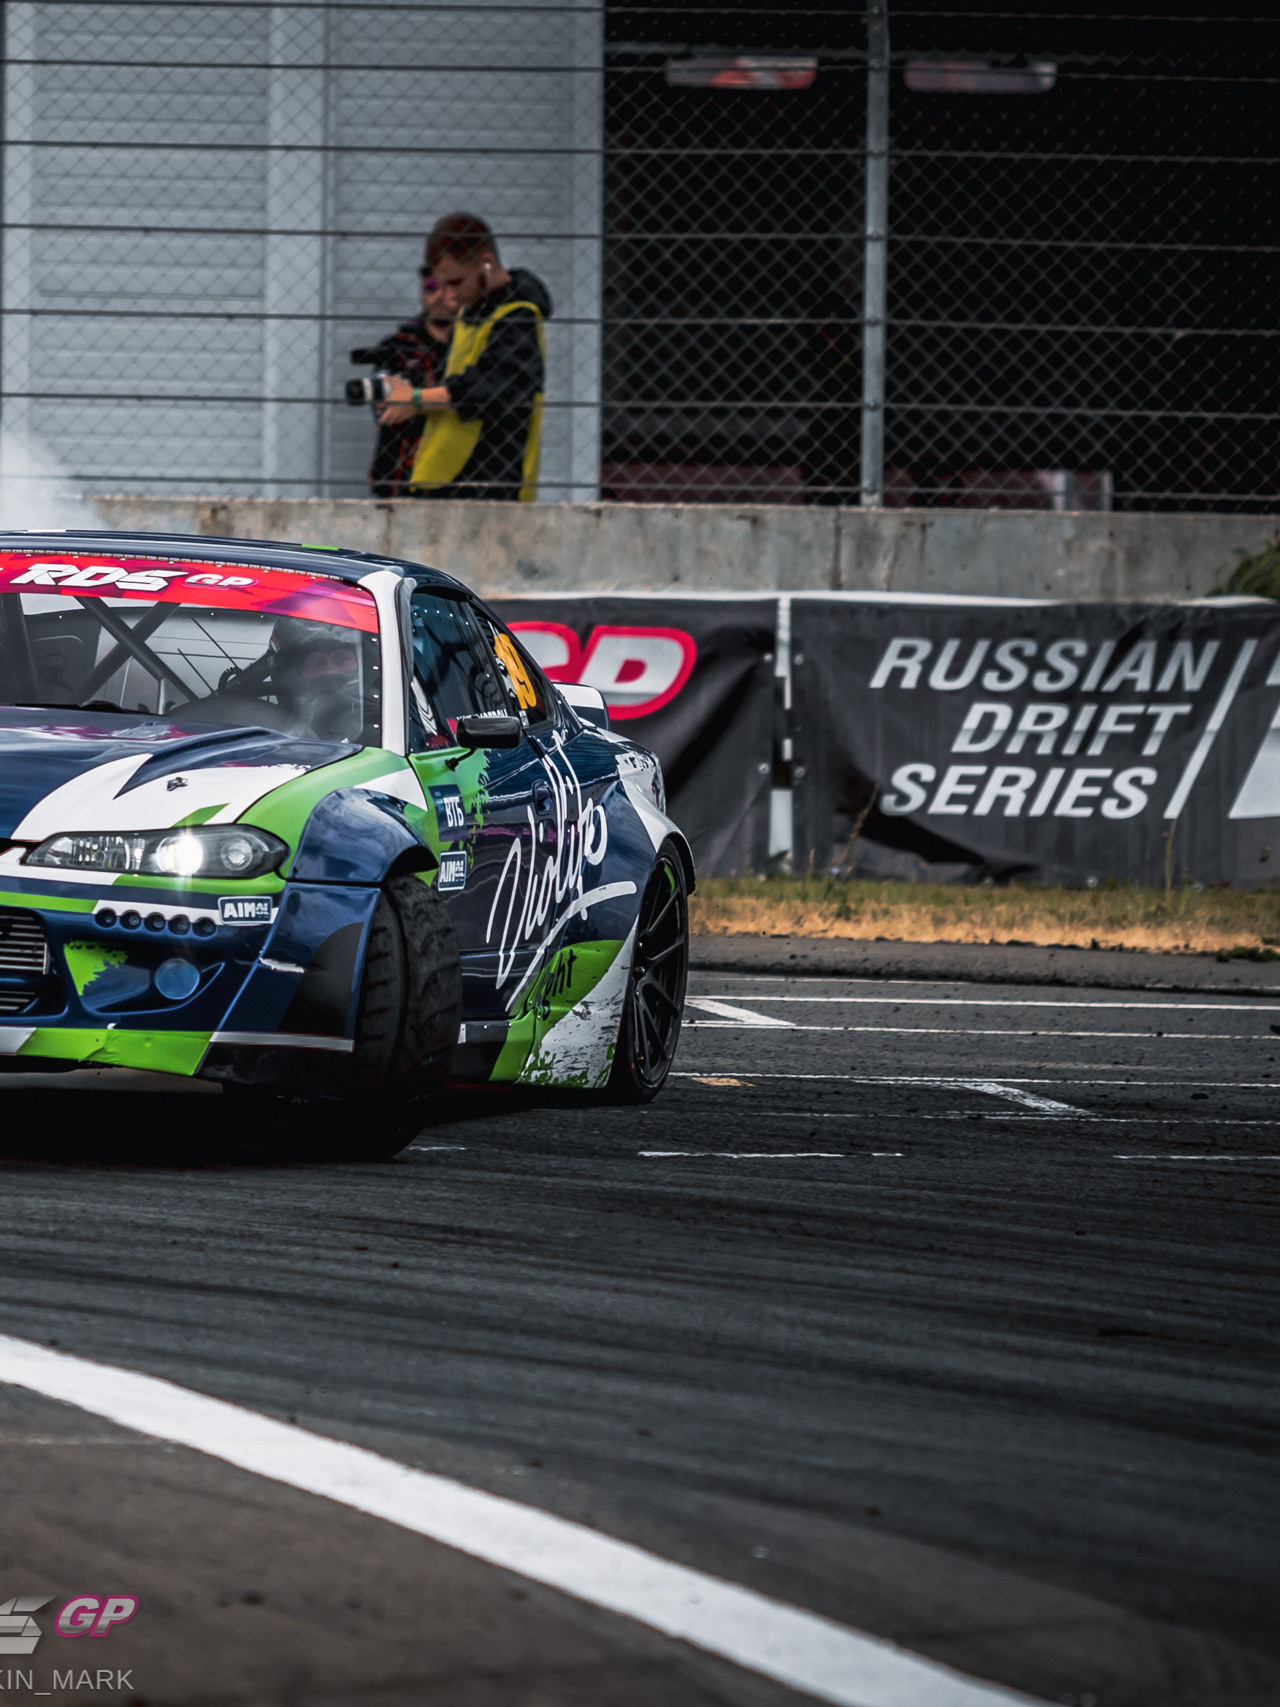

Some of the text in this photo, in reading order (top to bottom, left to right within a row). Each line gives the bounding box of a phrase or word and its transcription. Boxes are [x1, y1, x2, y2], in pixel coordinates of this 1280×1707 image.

[9, 563, 259, 592] RDS GP
[868, 637, 1221, 692] RUSSIAN
[951, 703, 1193, 757] DRIFT
[880, 763, 1158, 819] SERIES
